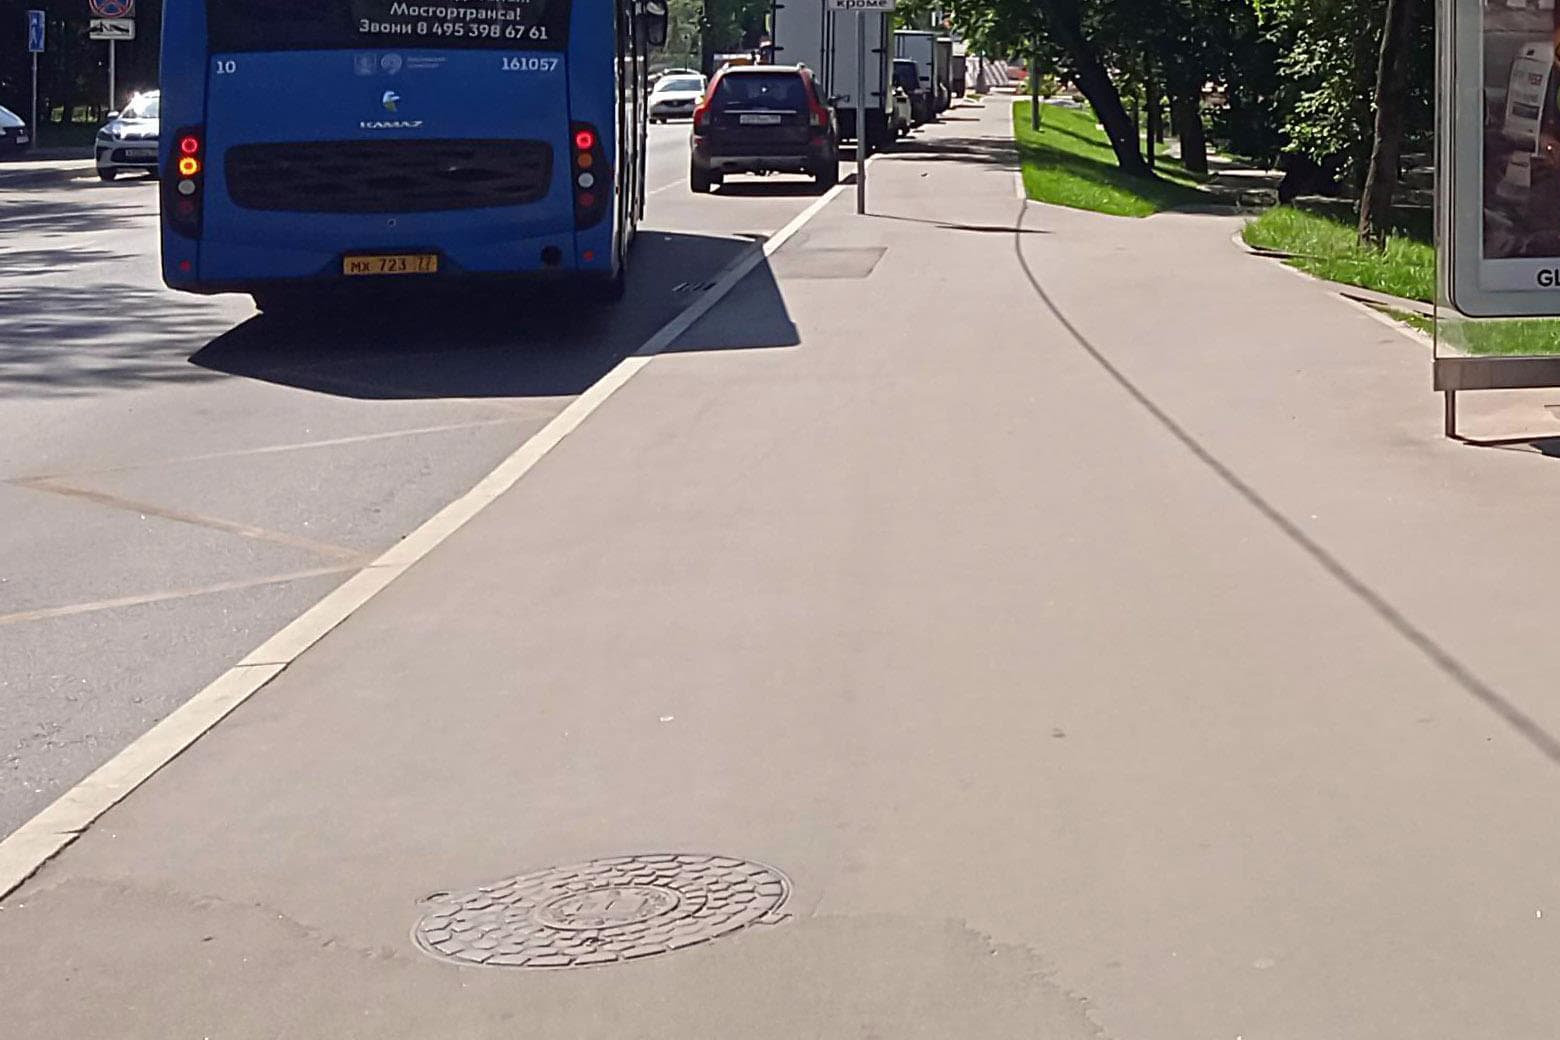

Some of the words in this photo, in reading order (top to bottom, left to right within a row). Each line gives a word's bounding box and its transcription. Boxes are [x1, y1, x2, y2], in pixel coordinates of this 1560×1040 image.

[390, 2, 521, 21] Мосгортранса!
[359, 19, 412, 34] Звони
[417, 22, 427, 35] 8
[432, 23, 464, 36] 495
[469, 24, 500, 37] 398
[505, 25, 525, 39] 67
[529, 26, 548, 40] 61
[216, 61, 236, 74] 10
[501, 57, 559, 72] 161057
